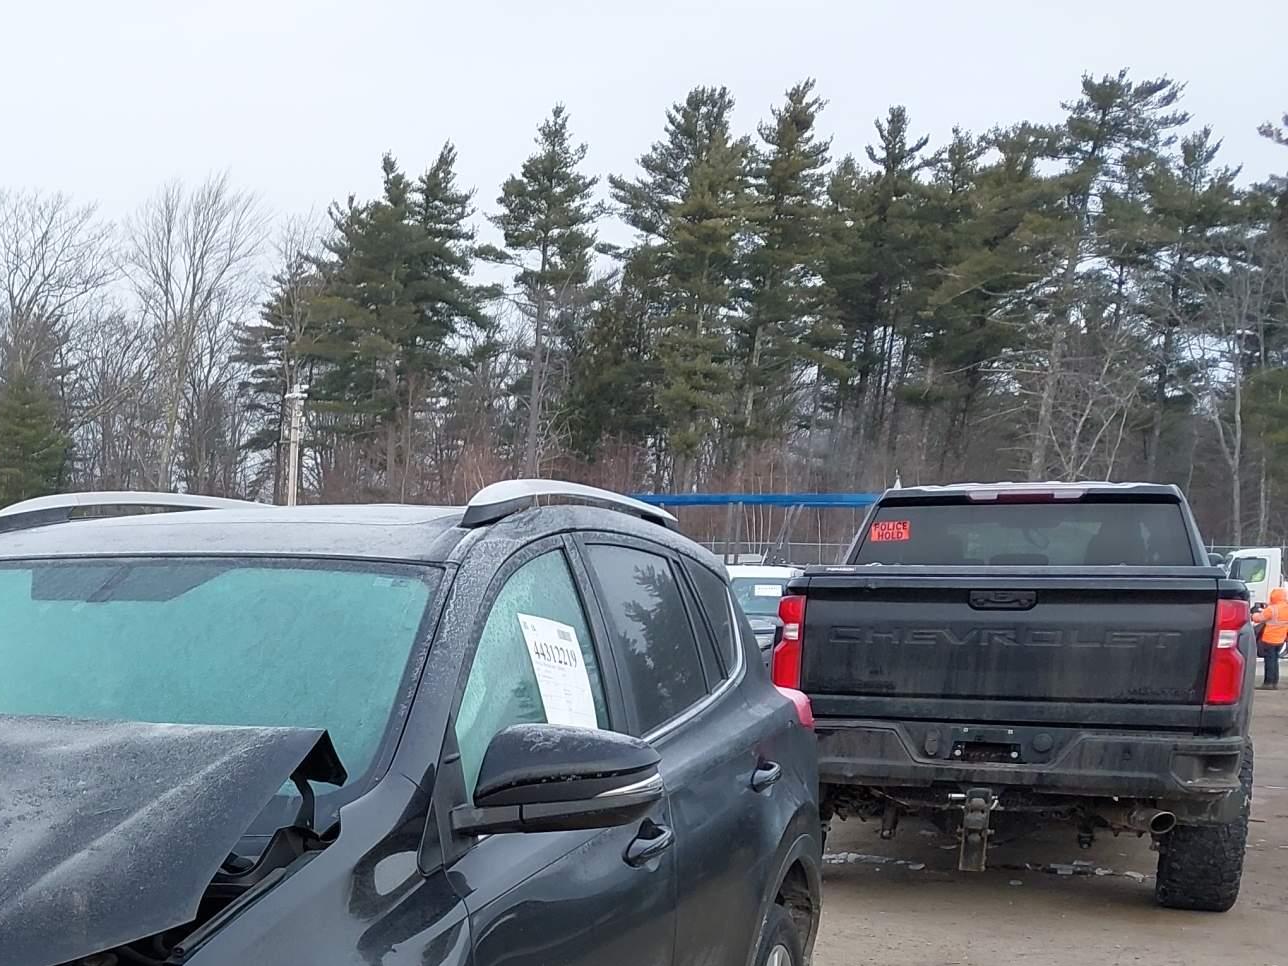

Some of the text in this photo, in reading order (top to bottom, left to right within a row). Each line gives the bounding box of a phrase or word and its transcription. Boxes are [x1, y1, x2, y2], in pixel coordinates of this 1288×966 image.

[873, 521, 908, 531] POLICE
[877, 531, 904, 541] HOLD
[829, 626, 1182, 649] CHEVROLET
[534, 641, 578, 669] 44312219
